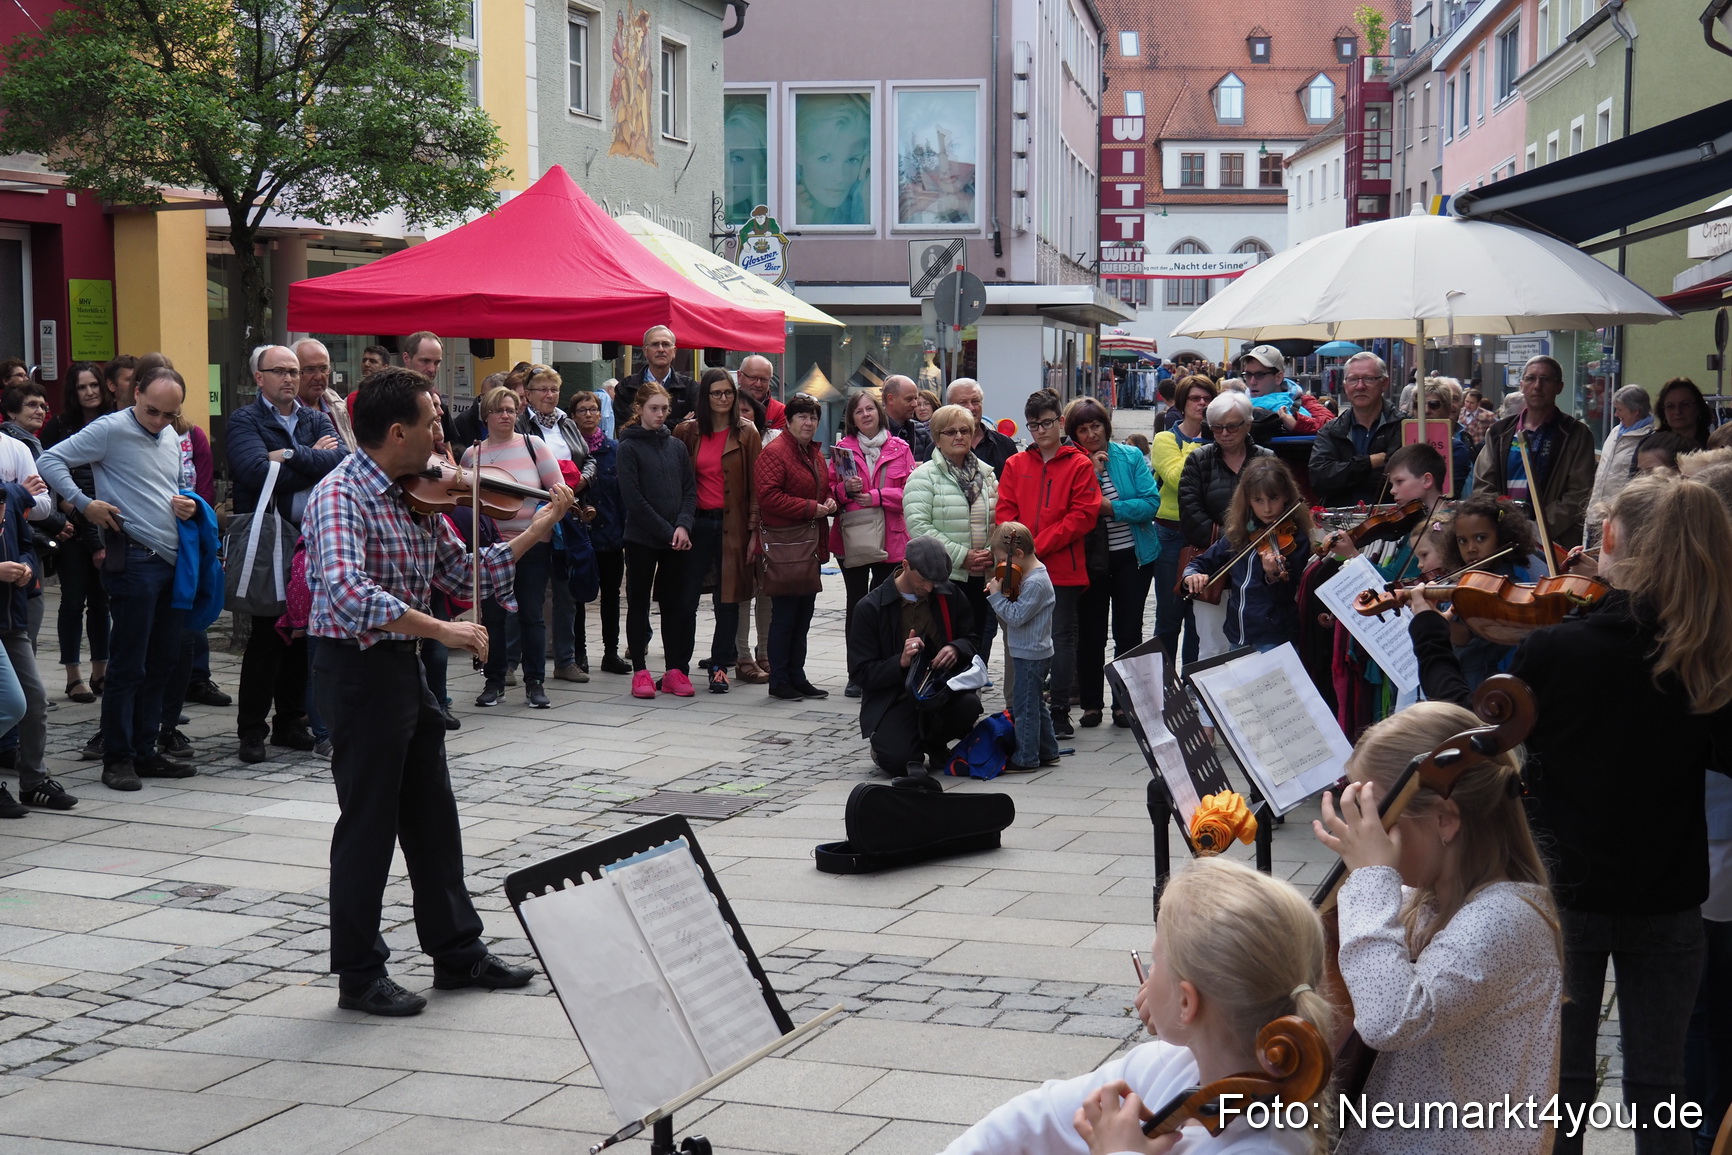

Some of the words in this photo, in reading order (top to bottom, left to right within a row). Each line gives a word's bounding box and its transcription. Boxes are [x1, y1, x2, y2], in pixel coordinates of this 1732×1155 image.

[1112, 117, 1144, 239] WITT
[1102, 248, 1143, 261] WITT
[764, 262, 781, 271] Bier
[1101, 263, 1143, 273] WEIDEN
[1202, 262, 1217, 270] der
[43, 327, 52, 335] 22
